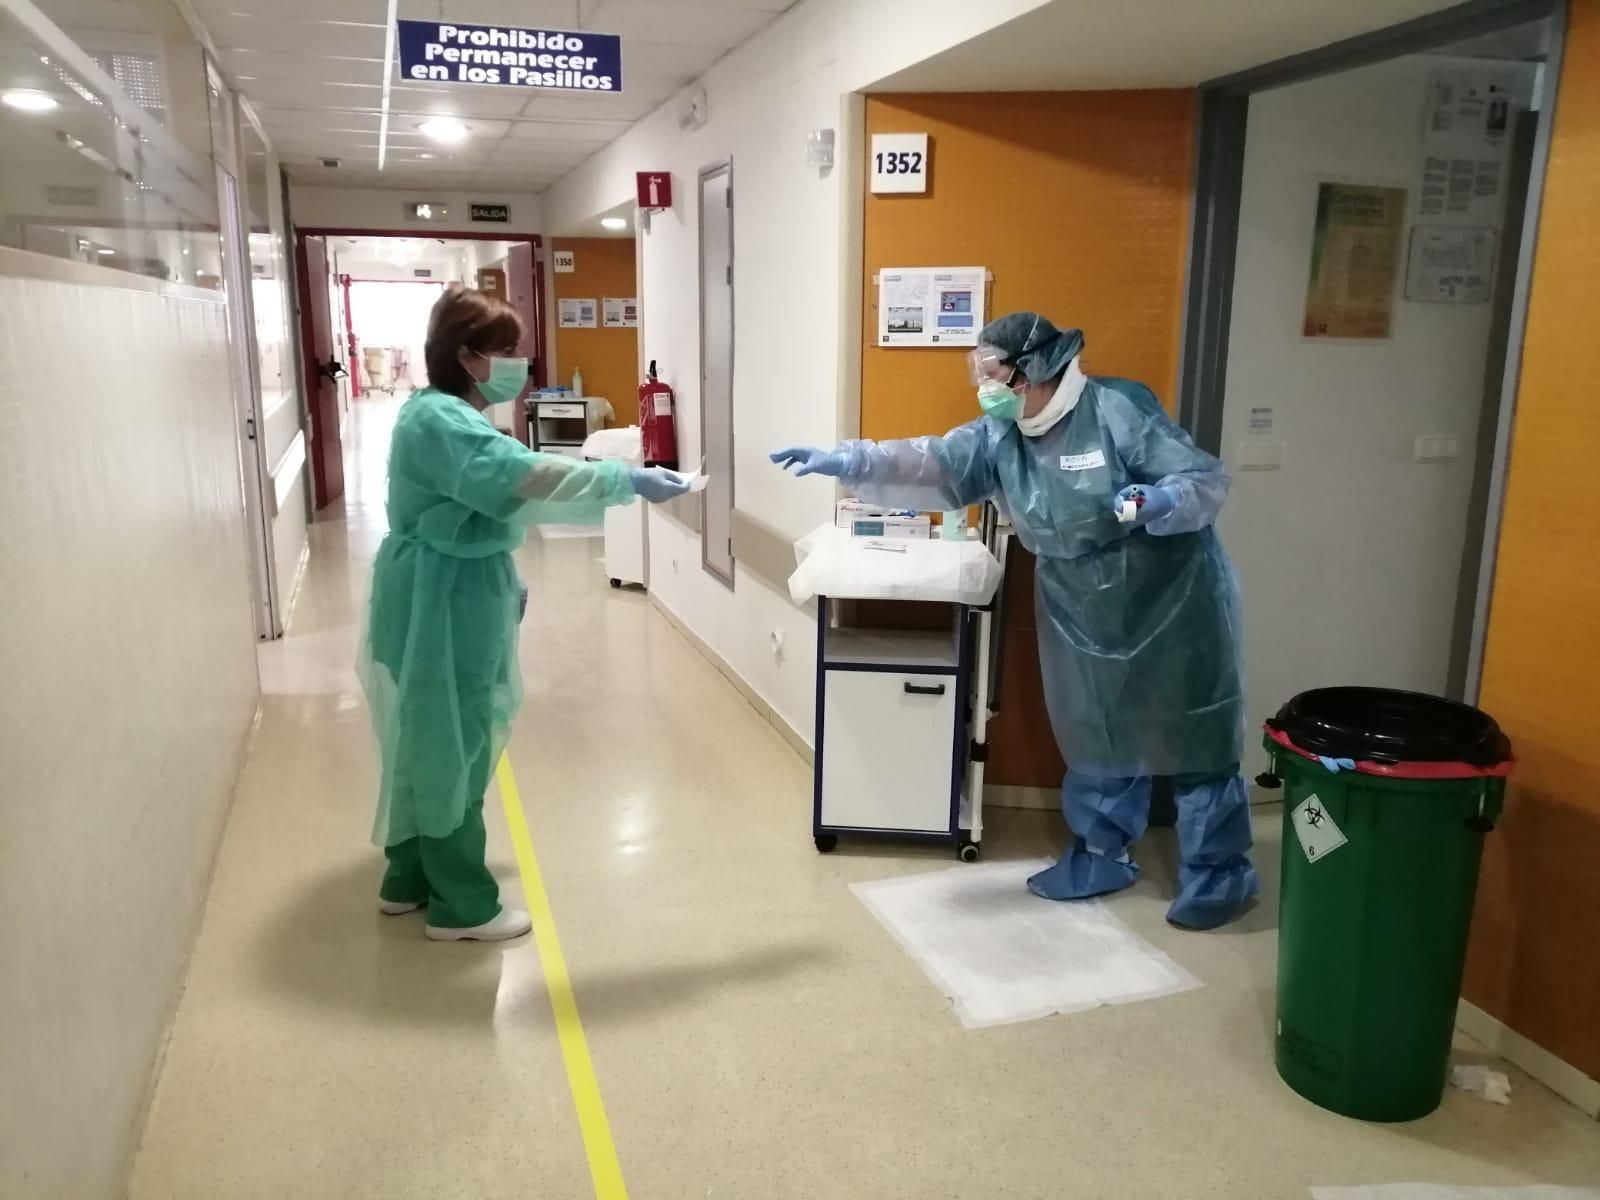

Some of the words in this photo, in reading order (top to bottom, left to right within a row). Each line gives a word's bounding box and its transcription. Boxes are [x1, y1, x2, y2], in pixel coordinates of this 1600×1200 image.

[438, 25, 583, 51] Prohibido
[425, 43, 598, 71] Permanecer
[410, 64, 449, 80] en
[458, 63, 500, 84] los
[509, 66, 612, 90] Pasillos
[876, 152, 922, 174] 1352
[472, 208, 506, 218] SALIDA
[555, 257, 572, 266] 1350
[1309, 845, 1315, 856] 6
